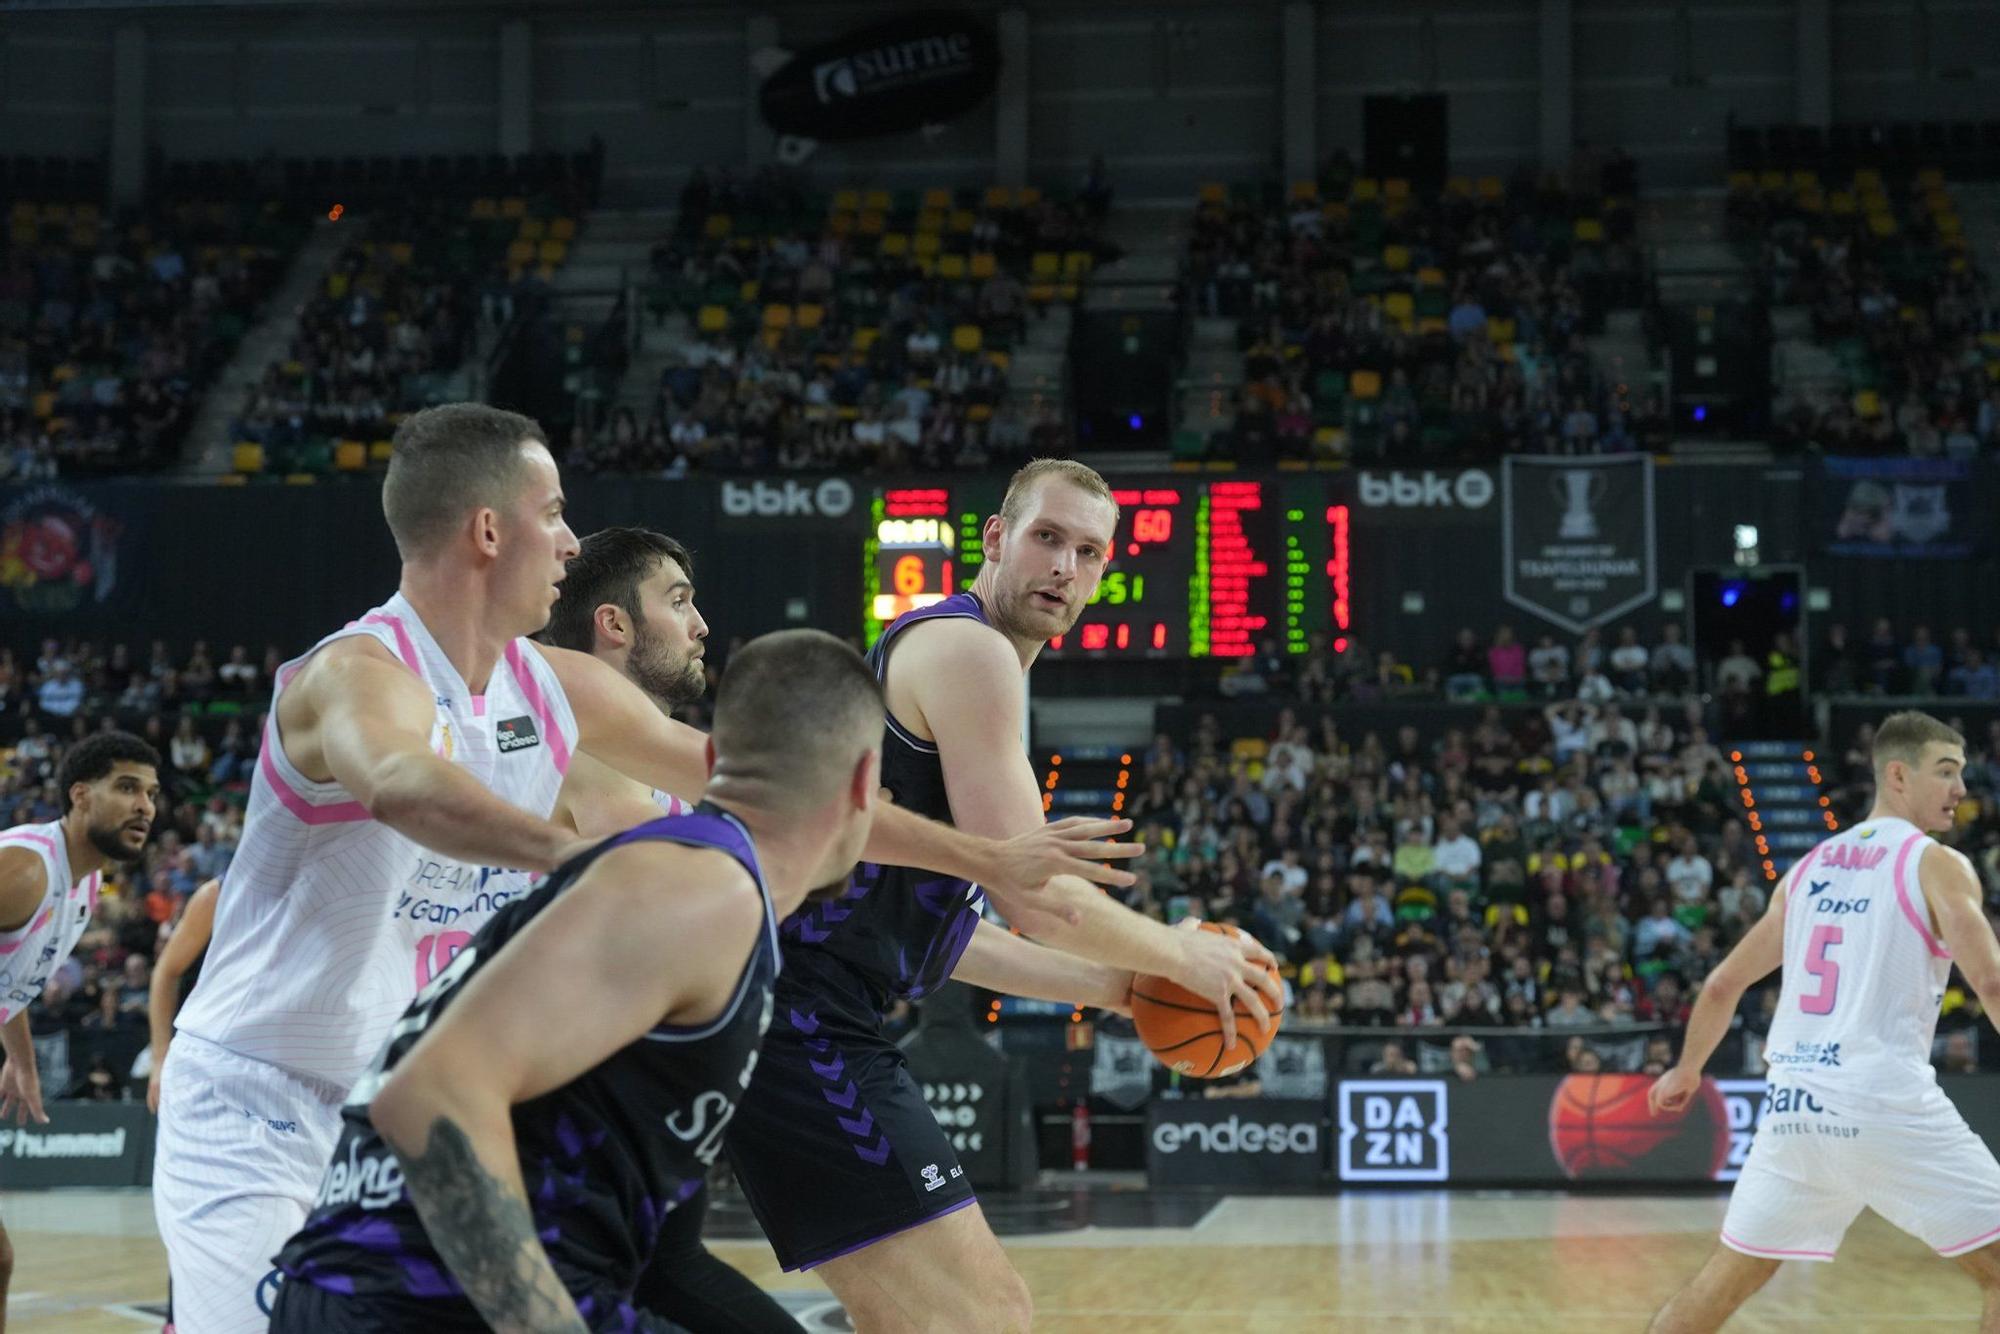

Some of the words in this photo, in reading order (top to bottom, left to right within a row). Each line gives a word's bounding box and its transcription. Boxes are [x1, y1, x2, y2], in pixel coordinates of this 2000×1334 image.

[722, 480, 813, 515] bbk
[1358, 471, 1452, 505] bbk
[894, 554, 925, 596] 6
[1799, 925, 1843, 1015] 5
[1364, 1096, 1422, 1129] DA
[1153, 1115, 1318, 1153] endesa
[1365, 1133, 1423, 1165] ZN
